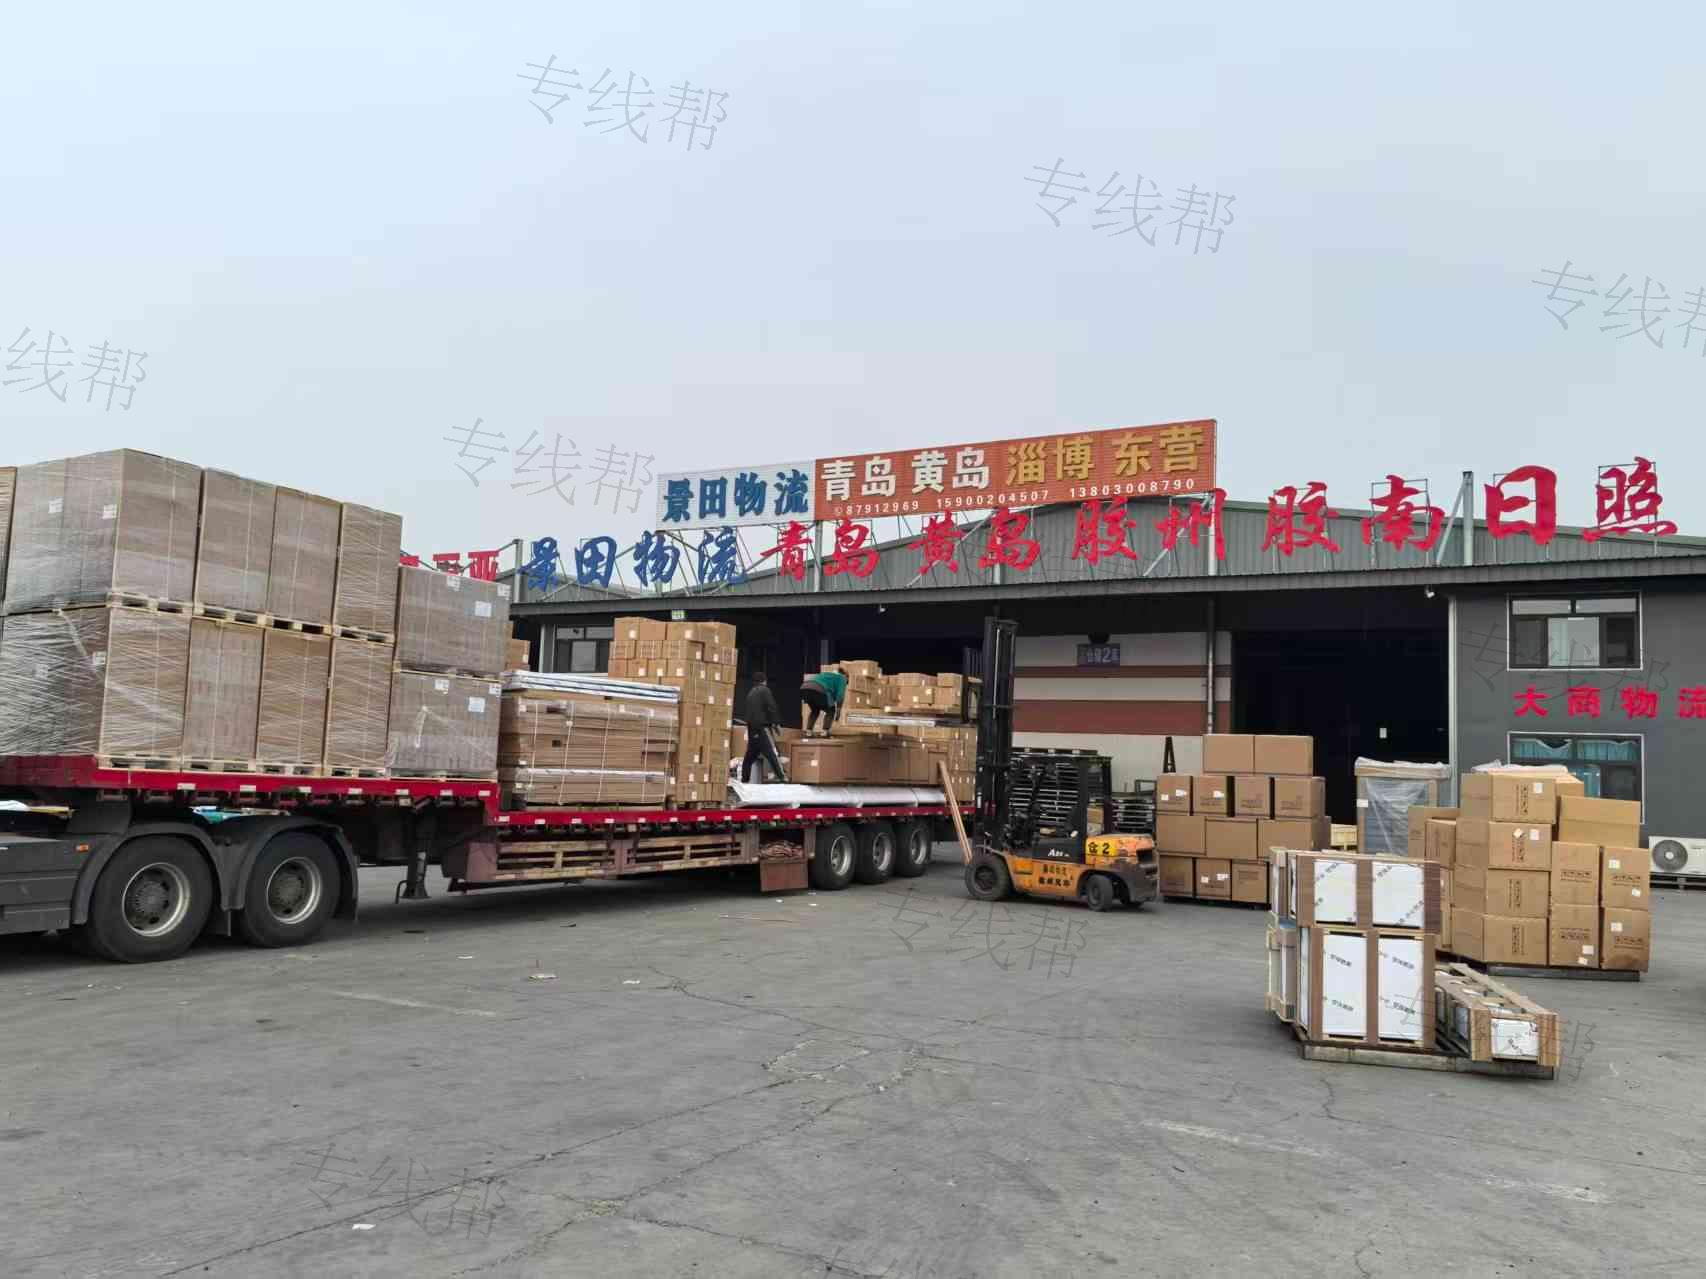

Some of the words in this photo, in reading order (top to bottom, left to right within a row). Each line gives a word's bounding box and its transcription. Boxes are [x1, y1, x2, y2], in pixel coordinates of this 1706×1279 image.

[820, 456, 898, 501] 青岛
[911, 446, 991, 493] 黄岛
[1005, 435, 1096, 487] 淄博
[1110, 424, 1203, 478] 东营
[936, 490, 1049, 509] 15900204507
[1069, 478, 1196, 499] 13803008790
[662, 469, 809, 523] 景田物流
[1484, 457, 1678, 546] 日照
[517, 527, 749, 591] 景田物流
